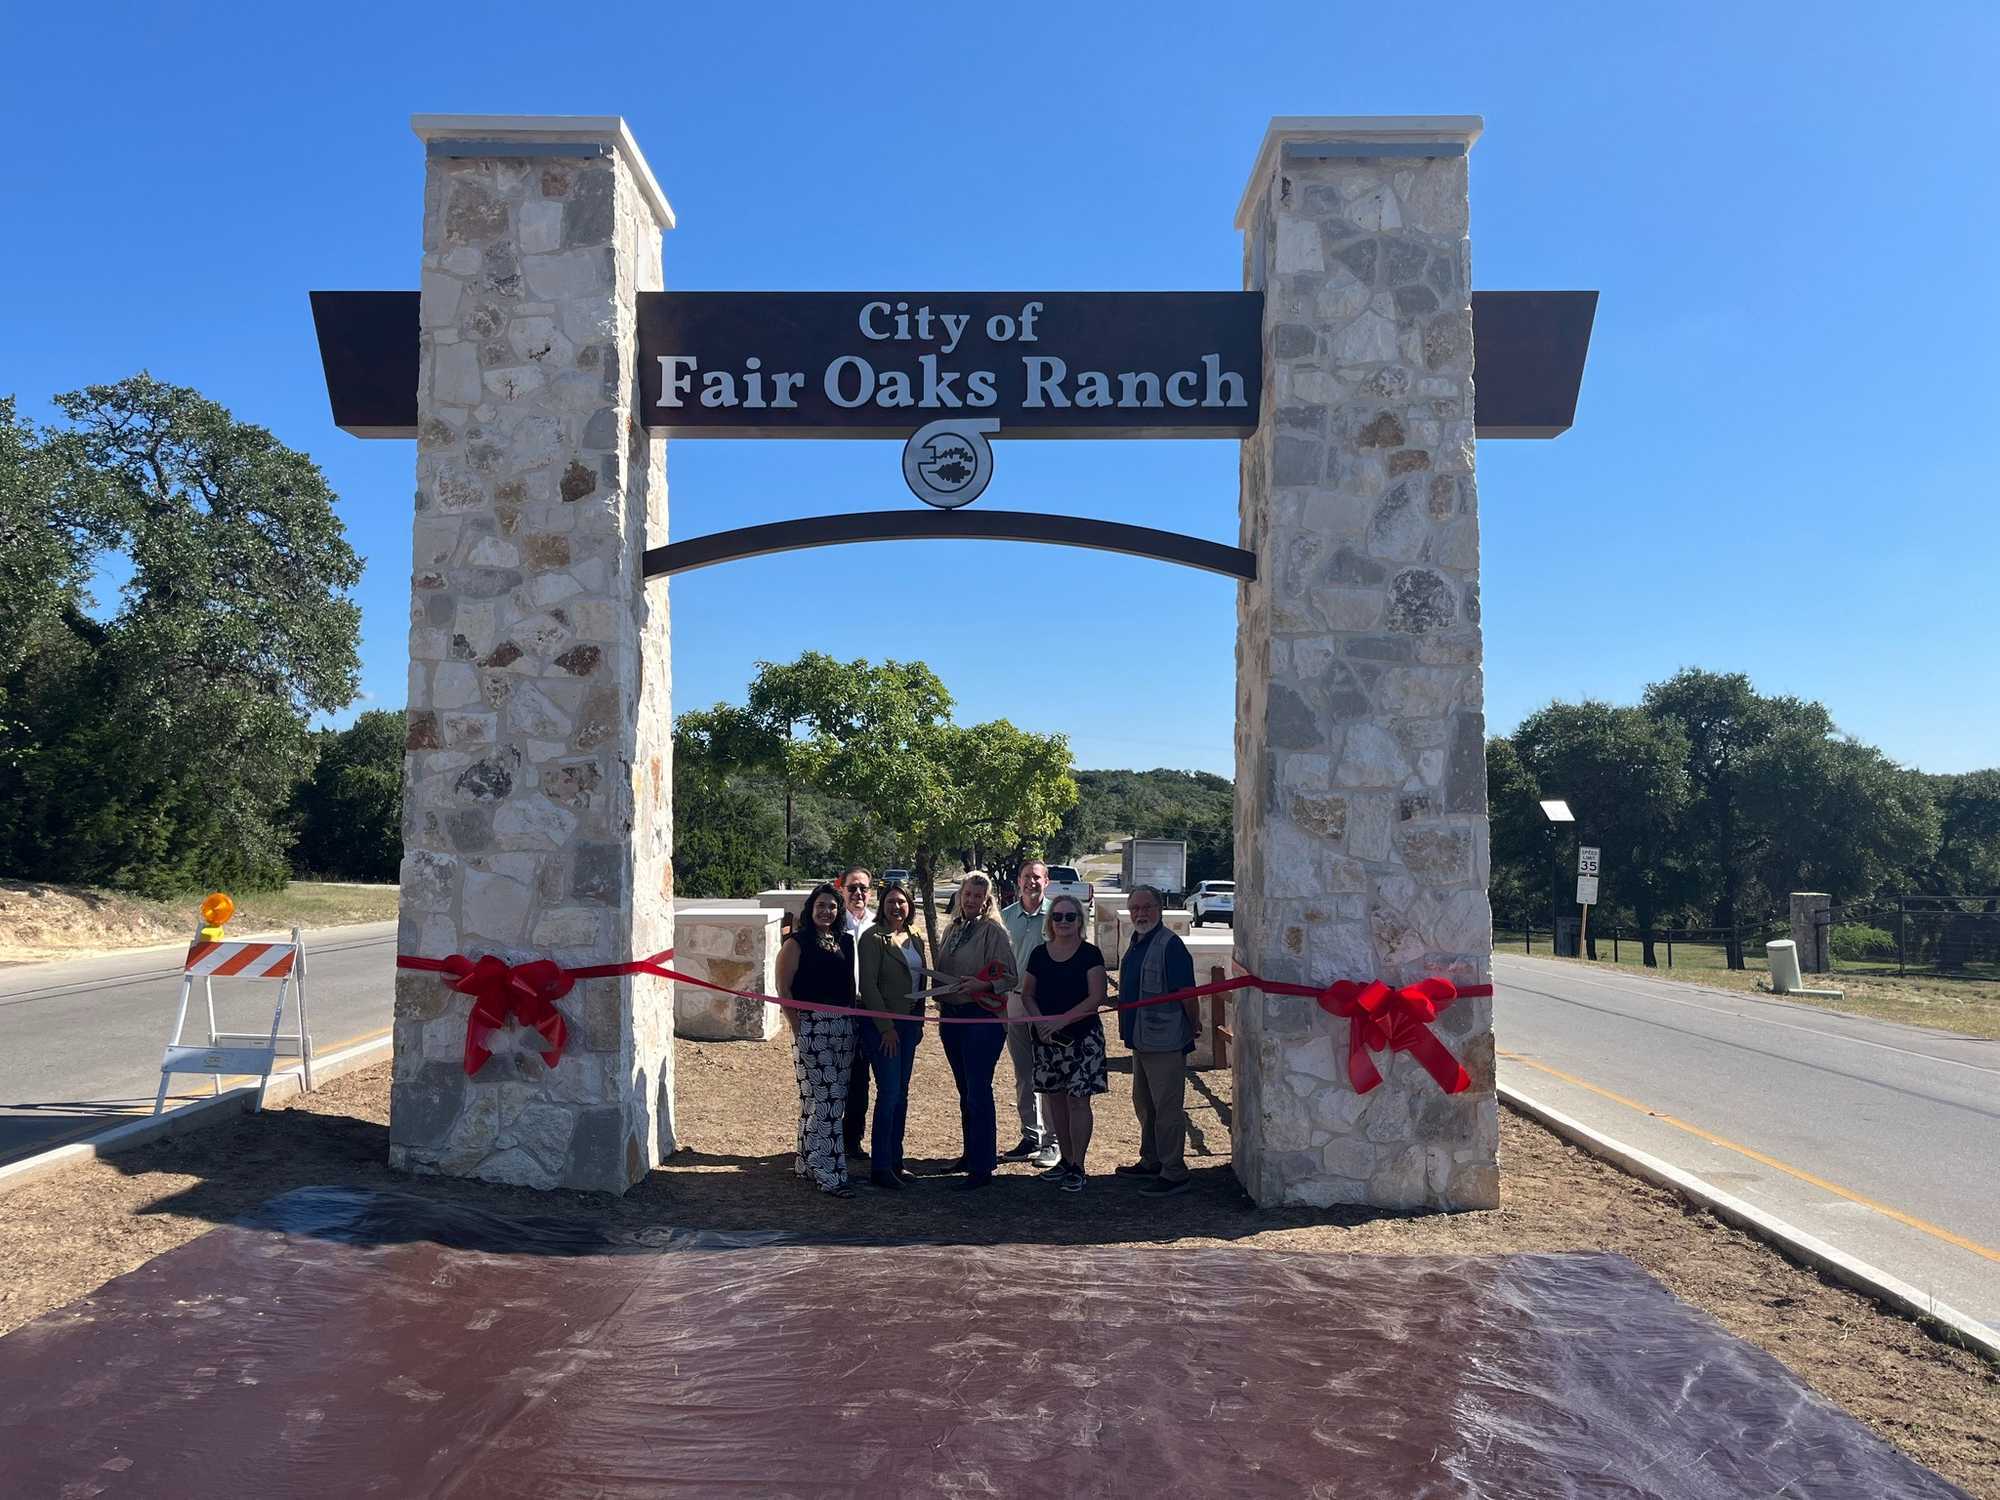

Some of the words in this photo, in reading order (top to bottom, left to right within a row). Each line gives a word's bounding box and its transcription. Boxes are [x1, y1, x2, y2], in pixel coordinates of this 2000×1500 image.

[859, 302, 970, 352] City
[986, 302, 1044, 342] of
[656, 356, 805, 408] Fair
[823, 353, 998, 408] Oaks
[1022, 353, 1248, 408] Ranch
[1581, 861, 1596, 871] 35
